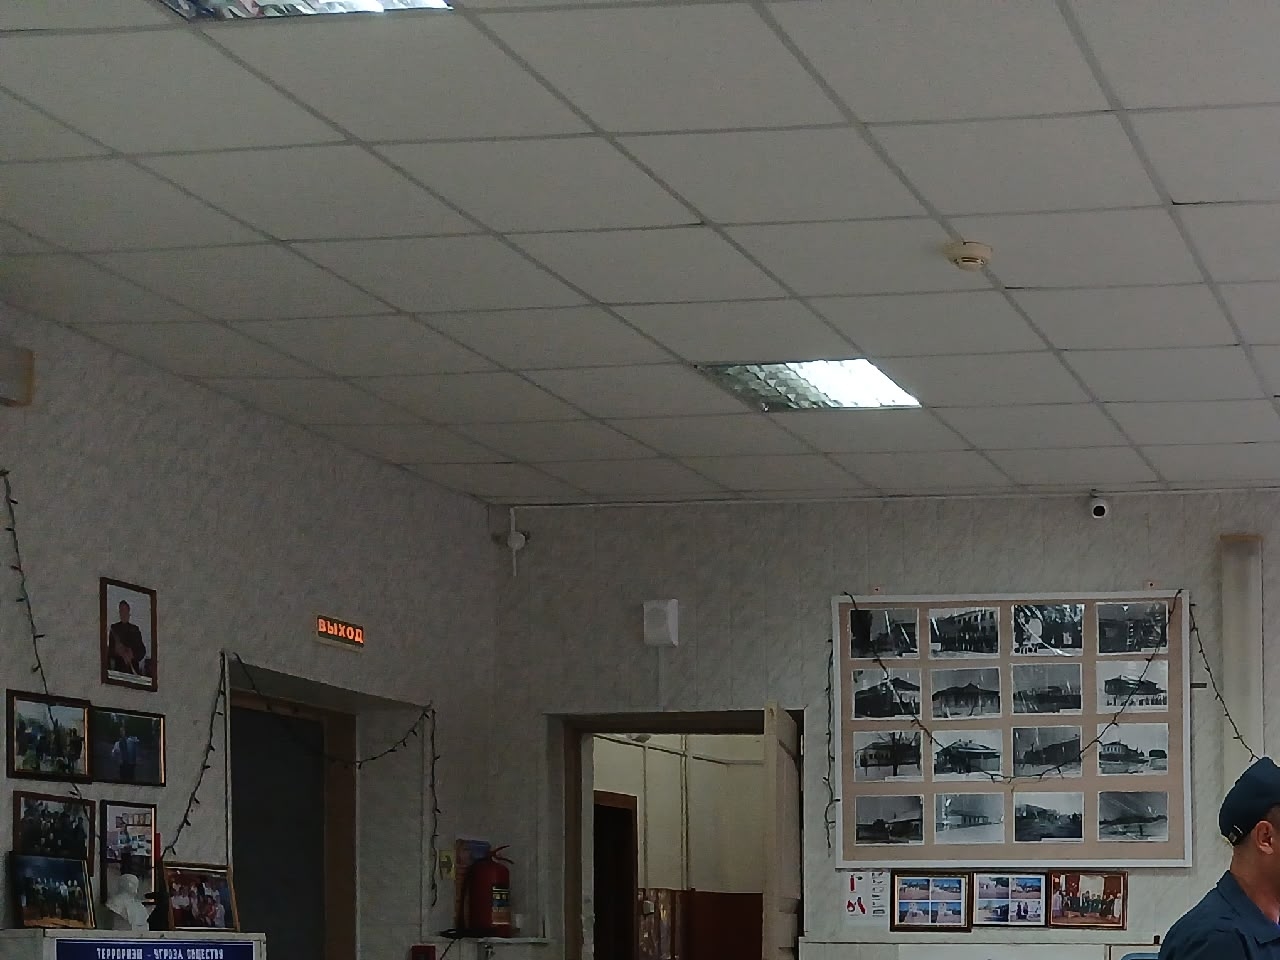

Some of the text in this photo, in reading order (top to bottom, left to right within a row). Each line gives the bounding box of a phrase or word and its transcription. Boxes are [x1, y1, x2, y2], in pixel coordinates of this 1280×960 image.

[318, 618, 363, 643] ВЫХОД
[96, 947, 143, 960] ТЕРРОРИЗМ
[153, 948, 184, 960] УГРОЗА
